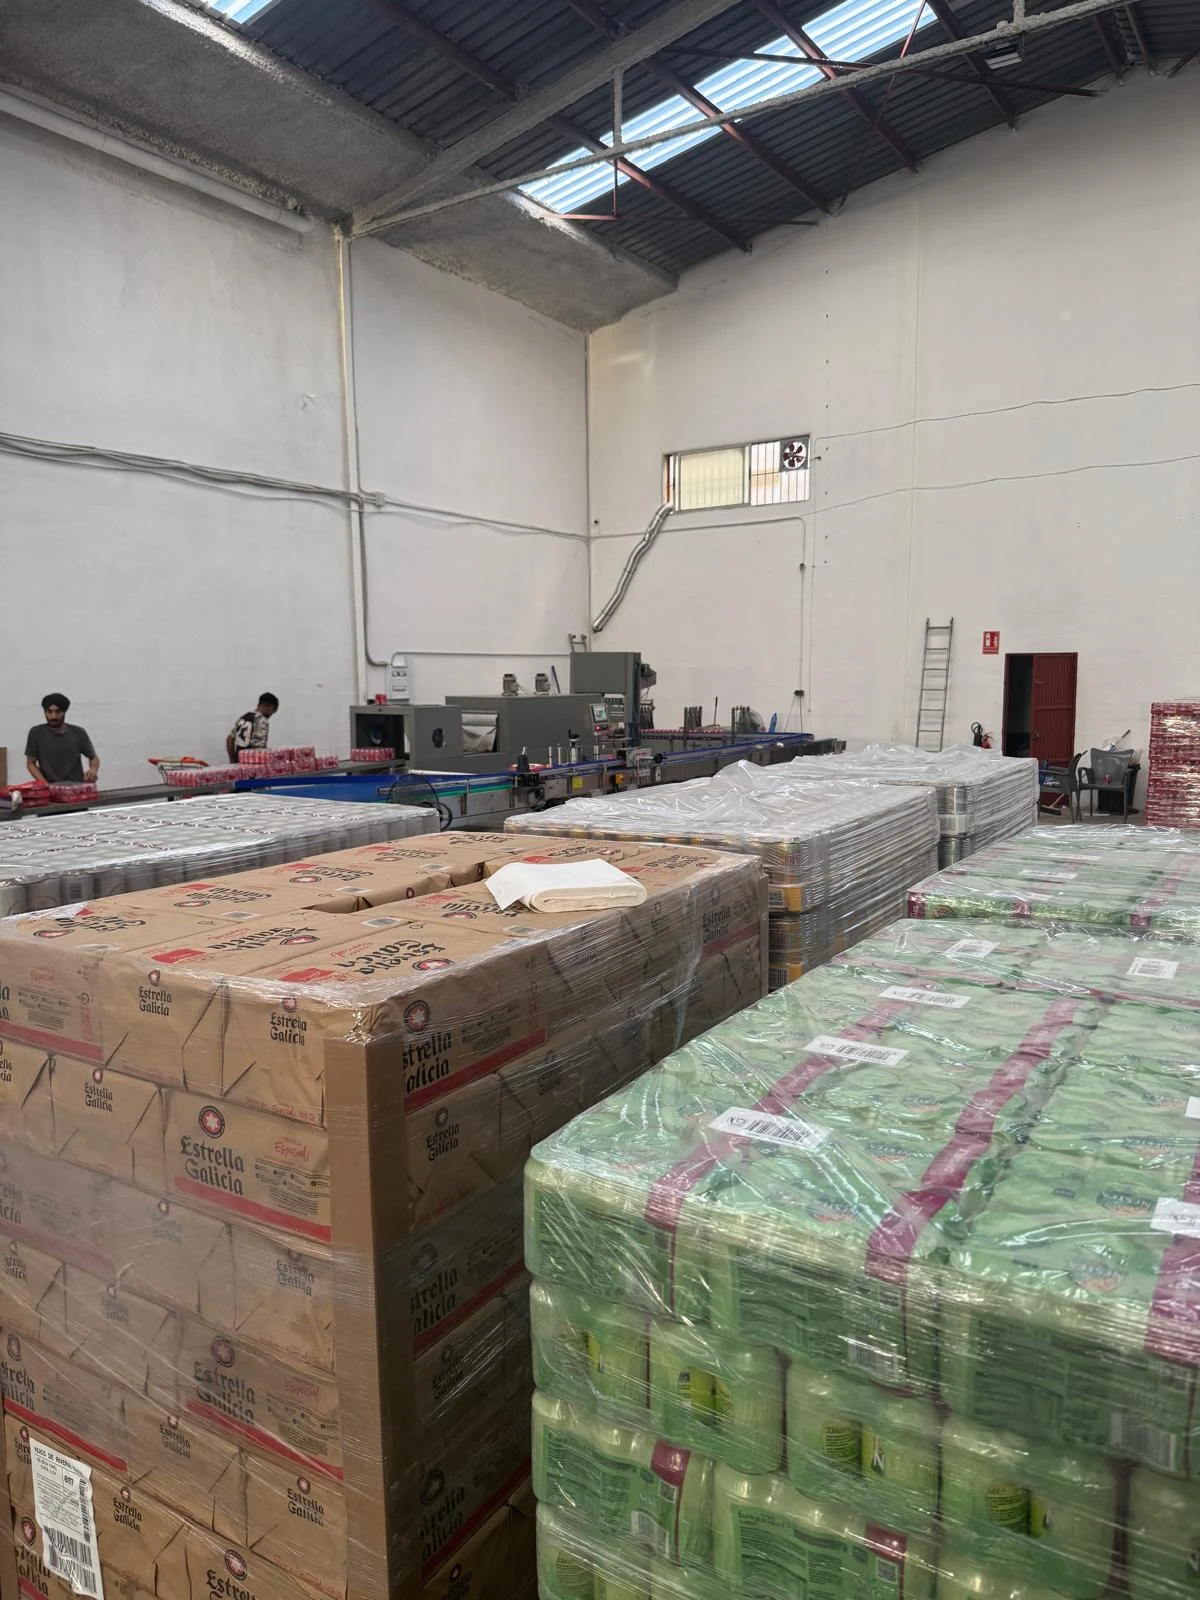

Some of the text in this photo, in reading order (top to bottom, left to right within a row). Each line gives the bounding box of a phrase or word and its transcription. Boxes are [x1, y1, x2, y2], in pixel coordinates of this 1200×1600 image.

[138, 986, 172, 1003] Estrella
[139, 1000, 170, 1017] Galicia
[269, 1026, 306, 1047] Galicia
[402, 1032, 452, 1071] strella
[405, 1054, 450, 1094] alicia
[84, 1081, 113, 1101] Estrella
[84, 1094, 113, 1113] Galicia
[426, 1123, 460, 1150] Estrella
[180, 1135, 245, 1173] Estrella
[184, 1158, 244, 1196] Galicia
[414, 1294, 456, 1336] alicia
[0, 1360, 35, 1394] strella
[193, 1361, 256, 1405] Estrella
[159, 1423, 191, 1450] Estrella
[112, 1497, 143, 1523] Estrella
[286, 1487, 324, 1516] Estrella
[113, 1507, 141, 1534] Galicia
[18, 1563, 49, 1597] alicia
